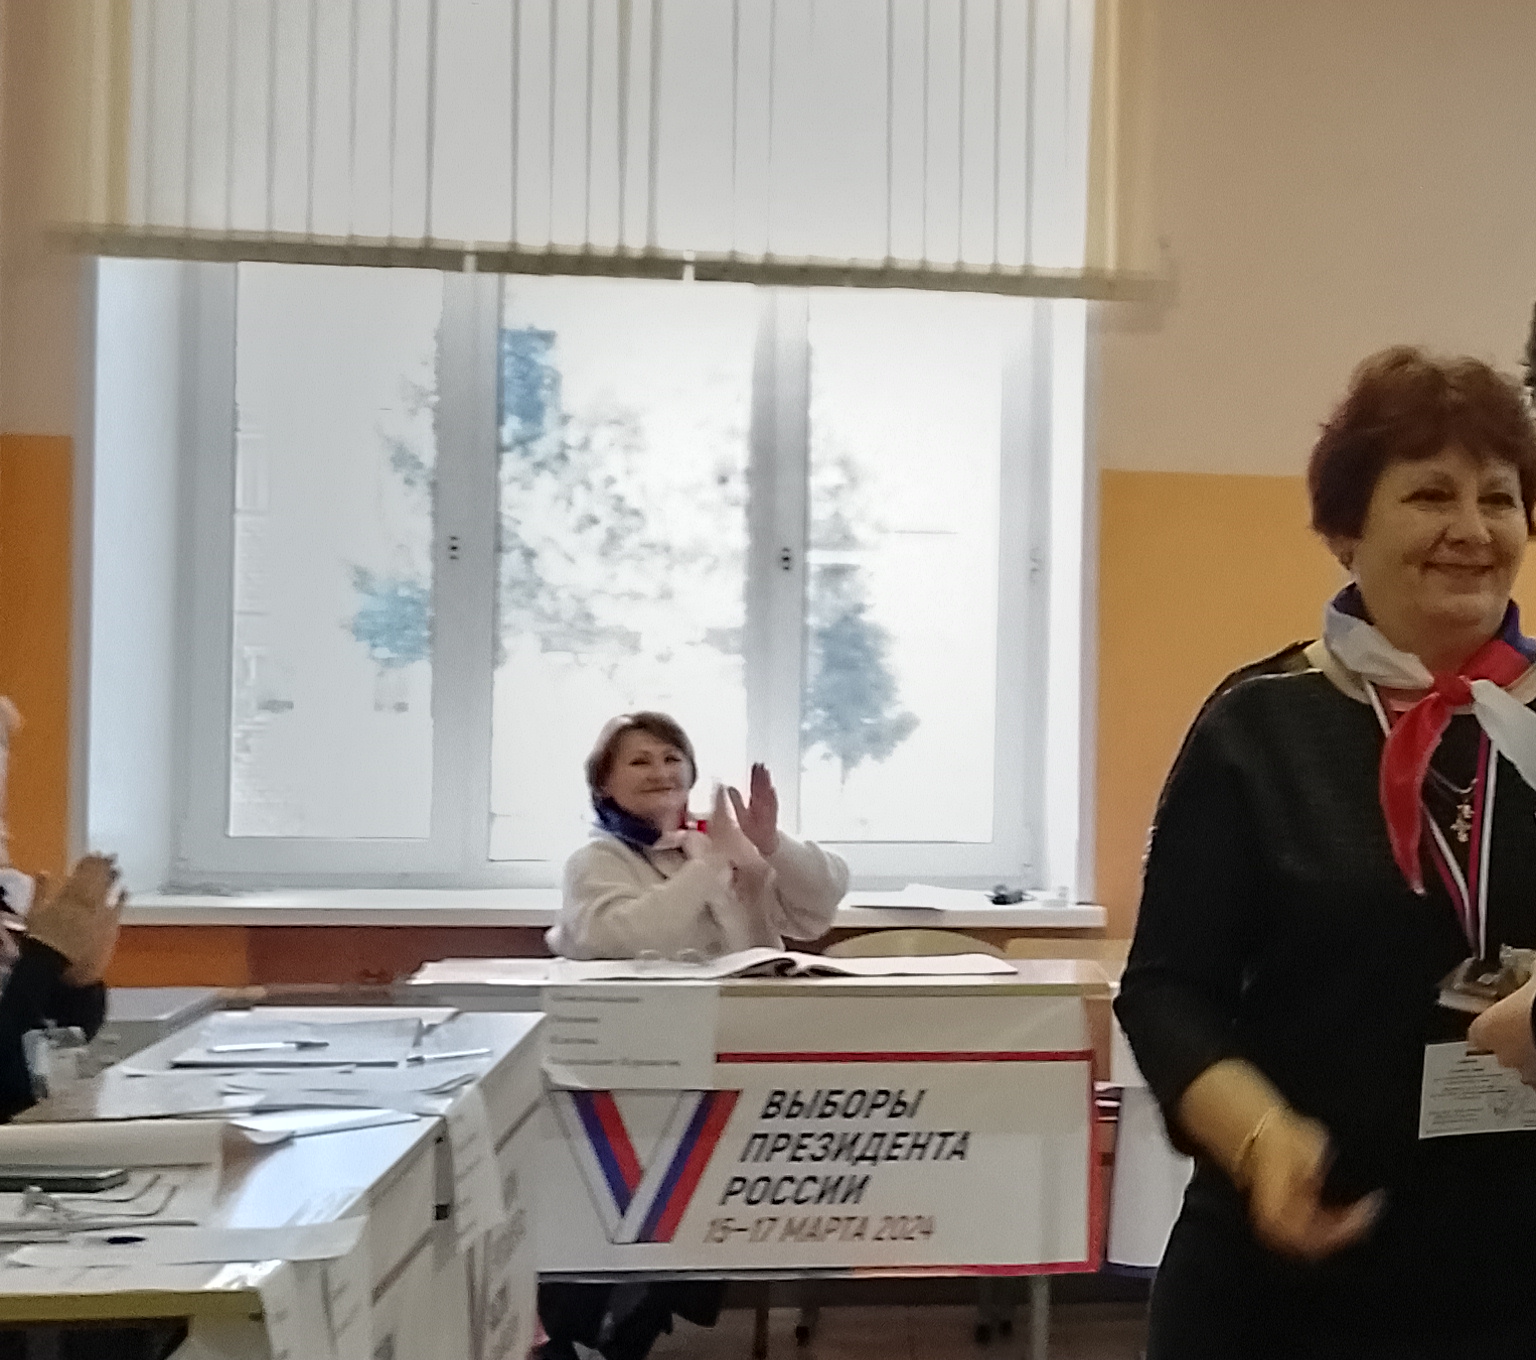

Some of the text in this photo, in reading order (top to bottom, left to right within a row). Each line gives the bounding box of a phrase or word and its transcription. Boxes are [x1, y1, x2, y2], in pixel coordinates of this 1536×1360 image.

[760, 1089, 927, 1119] ВЫБОРЫ
[738, 1131, 970, 1166] ПРЕЗИДЕНТА
[718, 1175, 871, 1205] РОССИИ
[778, 1216, 868, 1243] МАРТА
[871, 1215, 935, 1241] 2024
